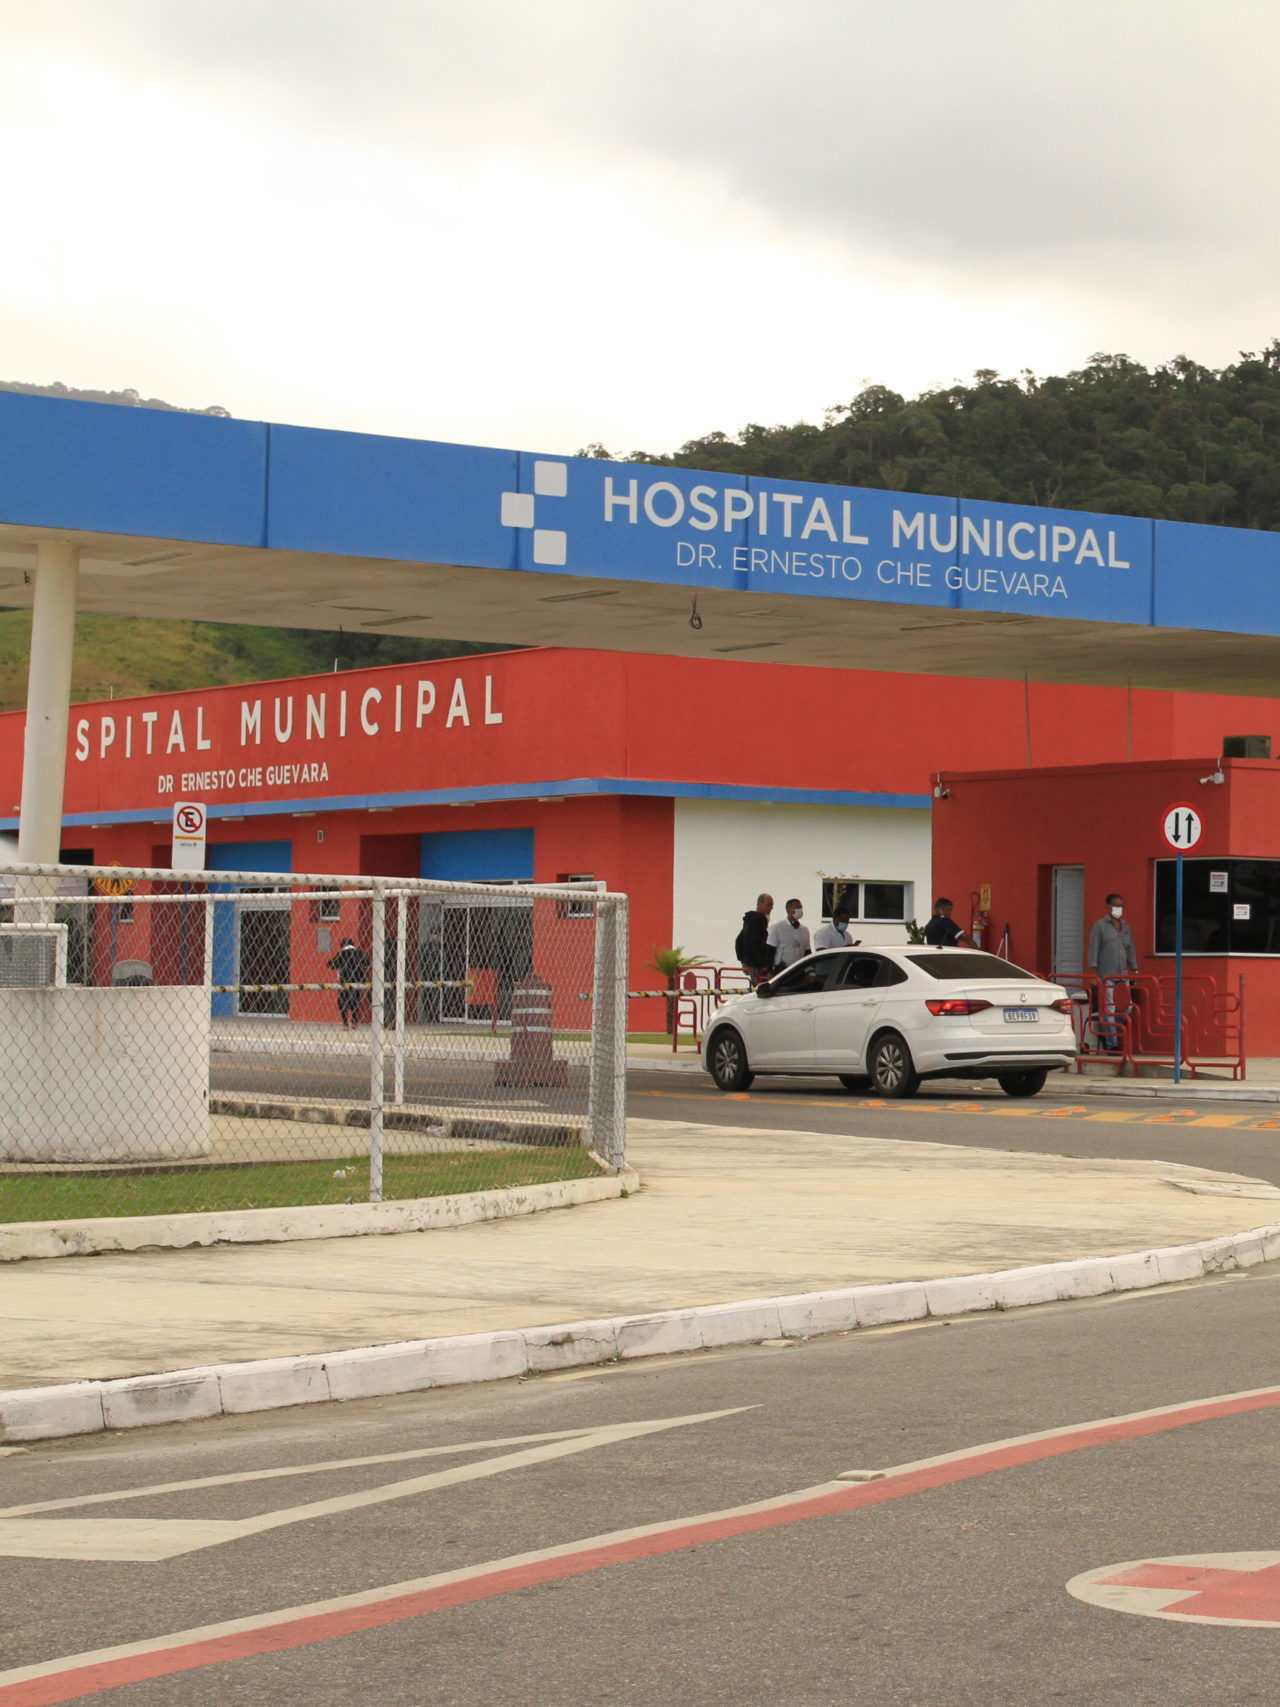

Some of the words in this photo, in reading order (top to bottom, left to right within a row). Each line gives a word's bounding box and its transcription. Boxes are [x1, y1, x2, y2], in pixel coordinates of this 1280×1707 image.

[604, 476, 869, 546] HOSPITAL
[892, 509, 1130, 569] MUNICIPAL
[677, 541, 722, 569] DR.
[733, 546, 862, 581] ERNESTO
[877, 559, 932, 587] CHE
[945, 566, 1068, 599] GUEVARA
[240, 675, 503, 746] MUNICIPAL
[157, 774, 174, 794] DR
[181, 769, 236, 792] ERNESTO
[238, 767, 263, 788] CHE
[266, 761, 329, 786] GUEVARA
